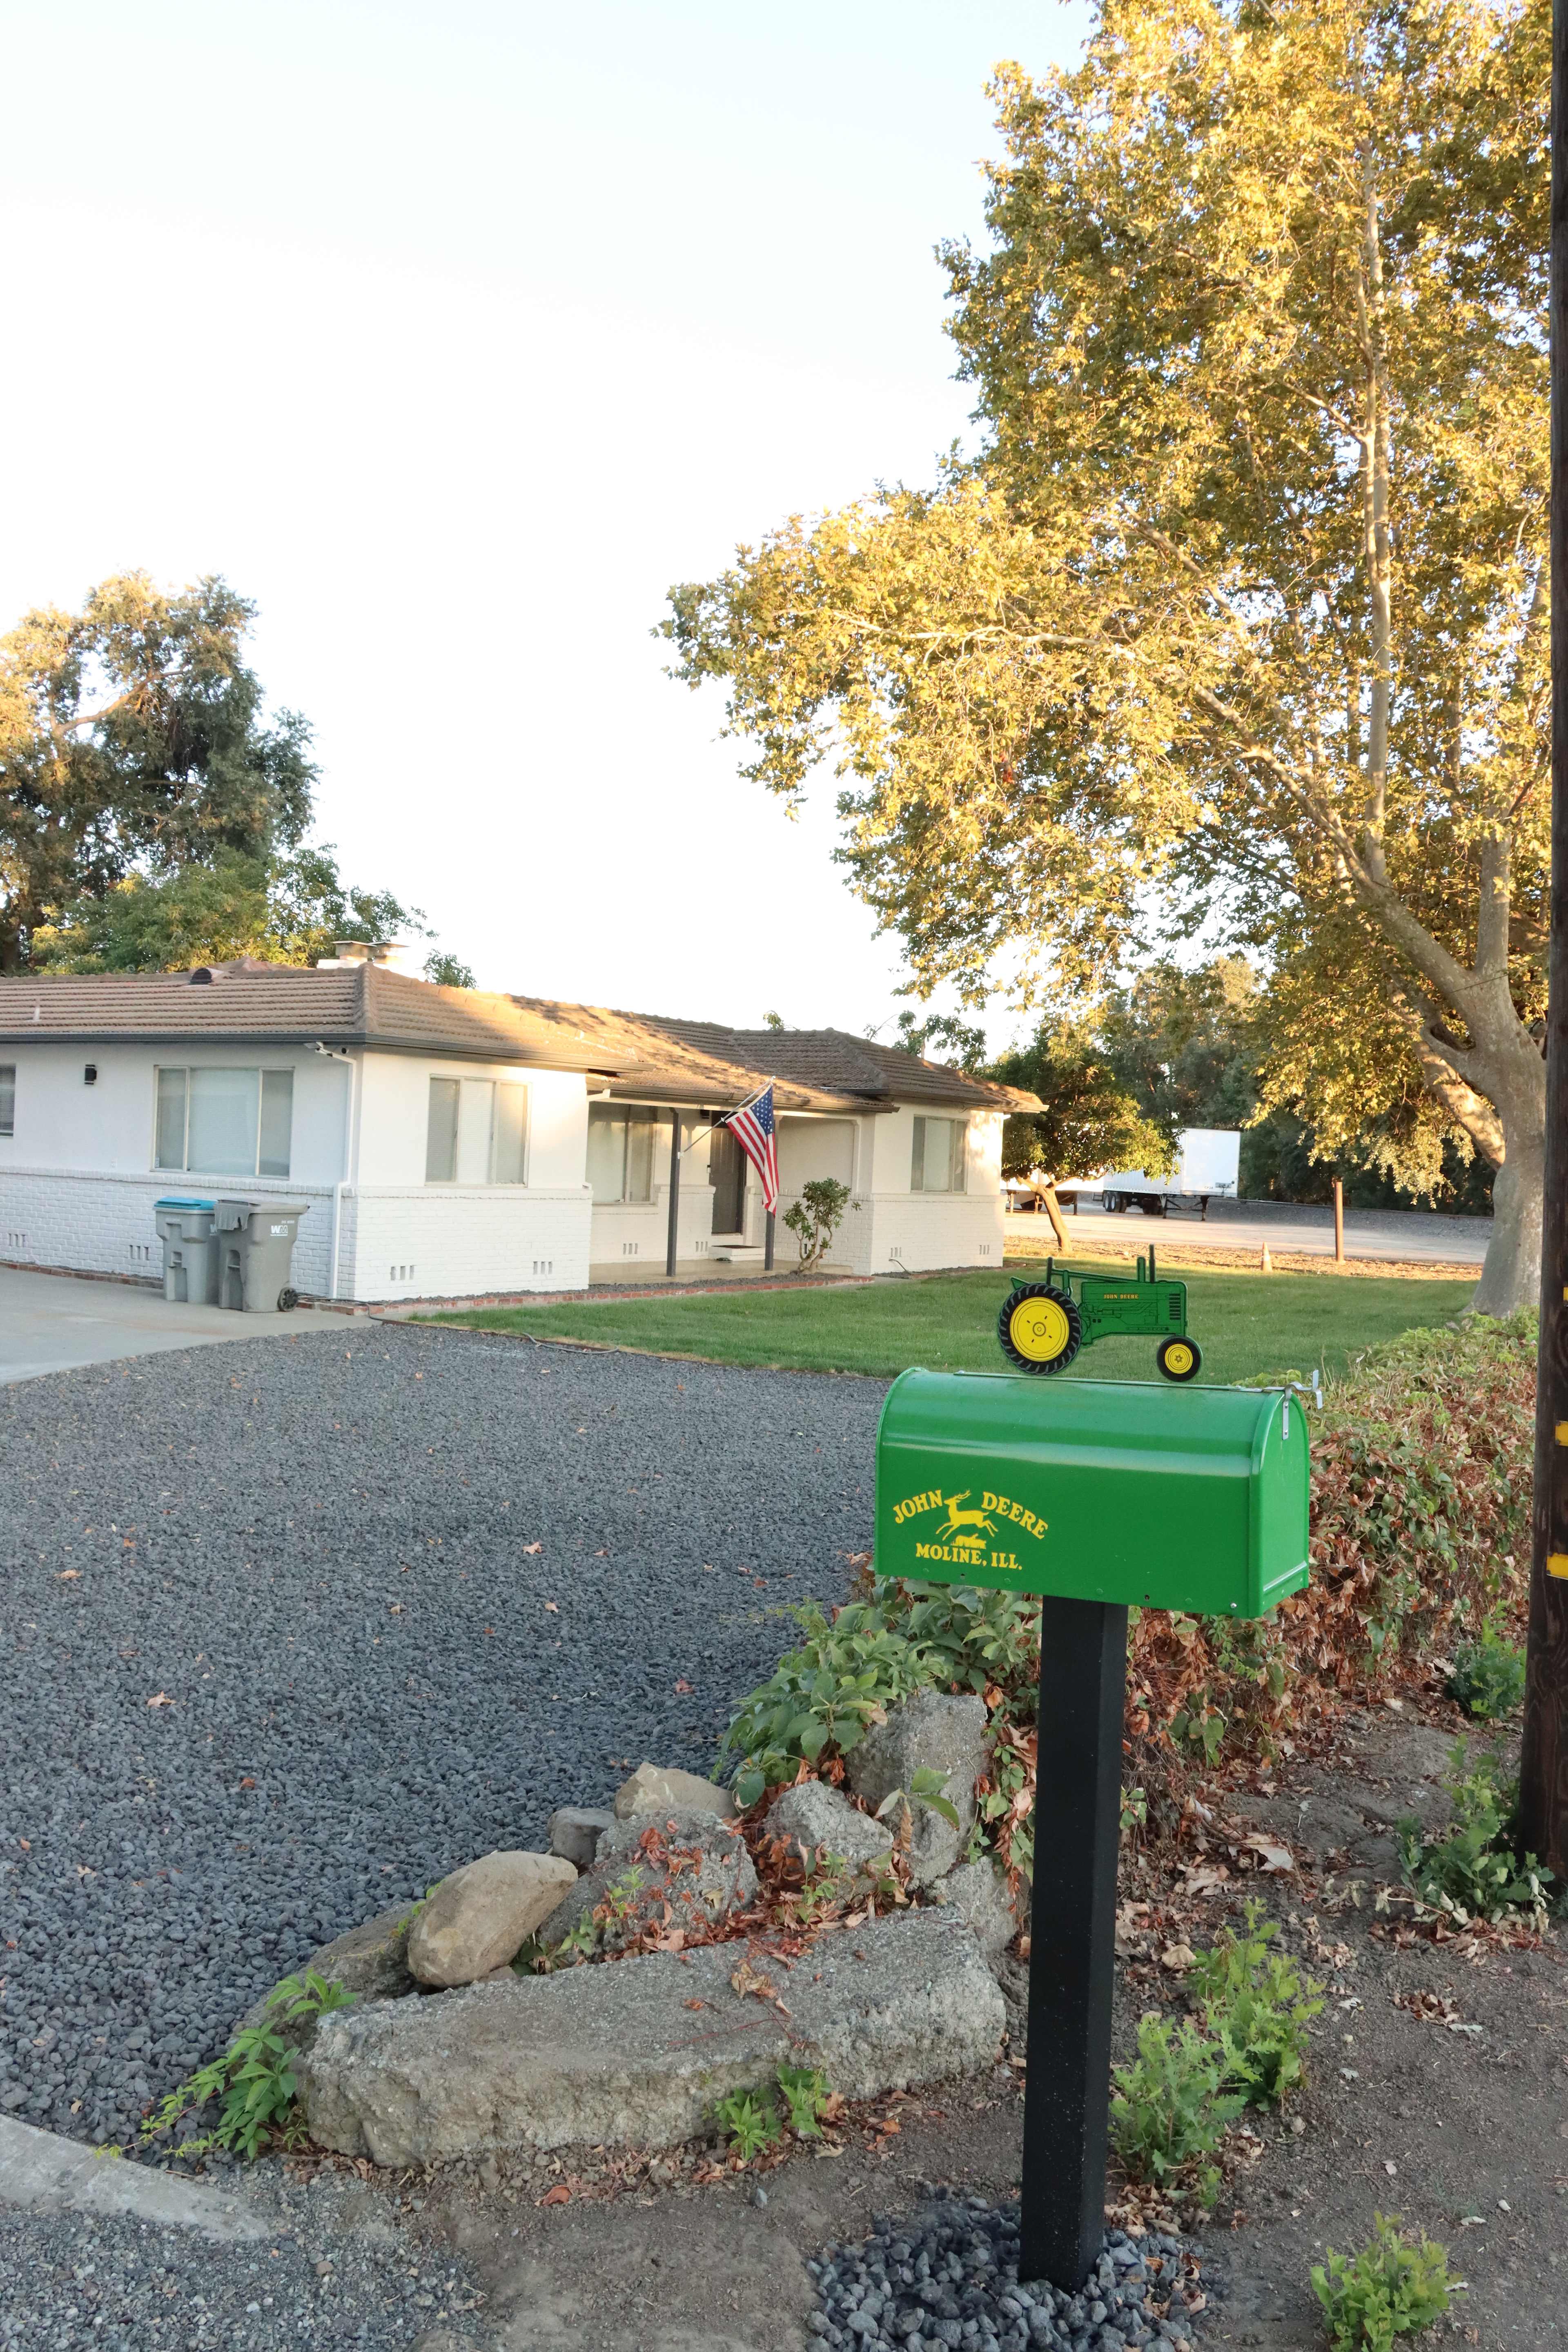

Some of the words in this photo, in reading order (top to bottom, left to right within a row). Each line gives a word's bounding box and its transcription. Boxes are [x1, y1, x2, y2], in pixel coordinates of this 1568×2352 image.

[271, 1225, 288, 1234] WM
[892, 1489, 943, 1524] JOHN
[980, 1491, 1049, 1540] DEERE
[915, 1542, 987, 1567] MOLINE,
[991, 1551, 1022, 1570] ILL.
